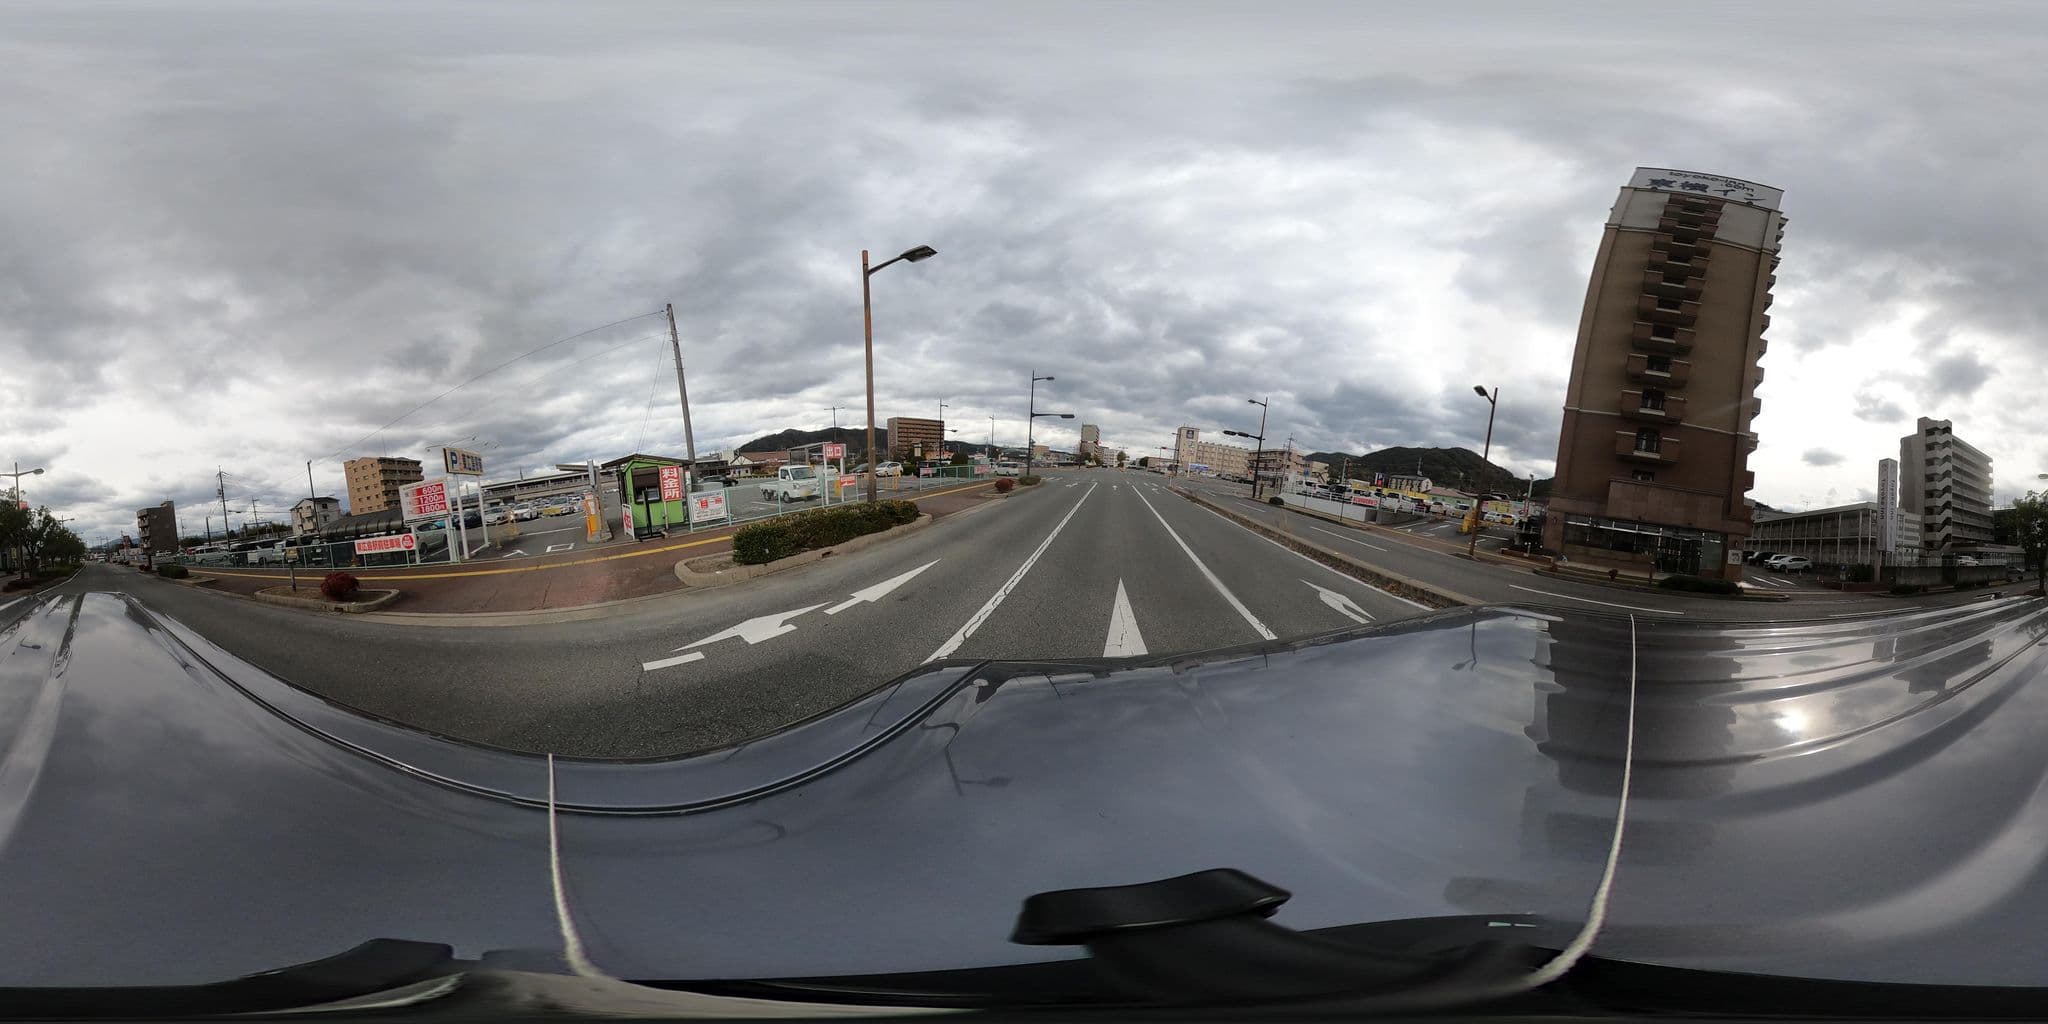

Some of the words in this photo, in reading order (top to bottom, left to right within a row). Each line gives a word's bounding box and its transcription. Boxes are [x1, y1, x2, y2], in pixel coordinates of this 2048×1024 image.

[826, 446, 842, 457] 出口
[450, 451, 458, 469] P
[662, 467, 681, 499] 料金所
[422, 485, 443, 495] 600円
[419, 493, 444, 504] 1200円
